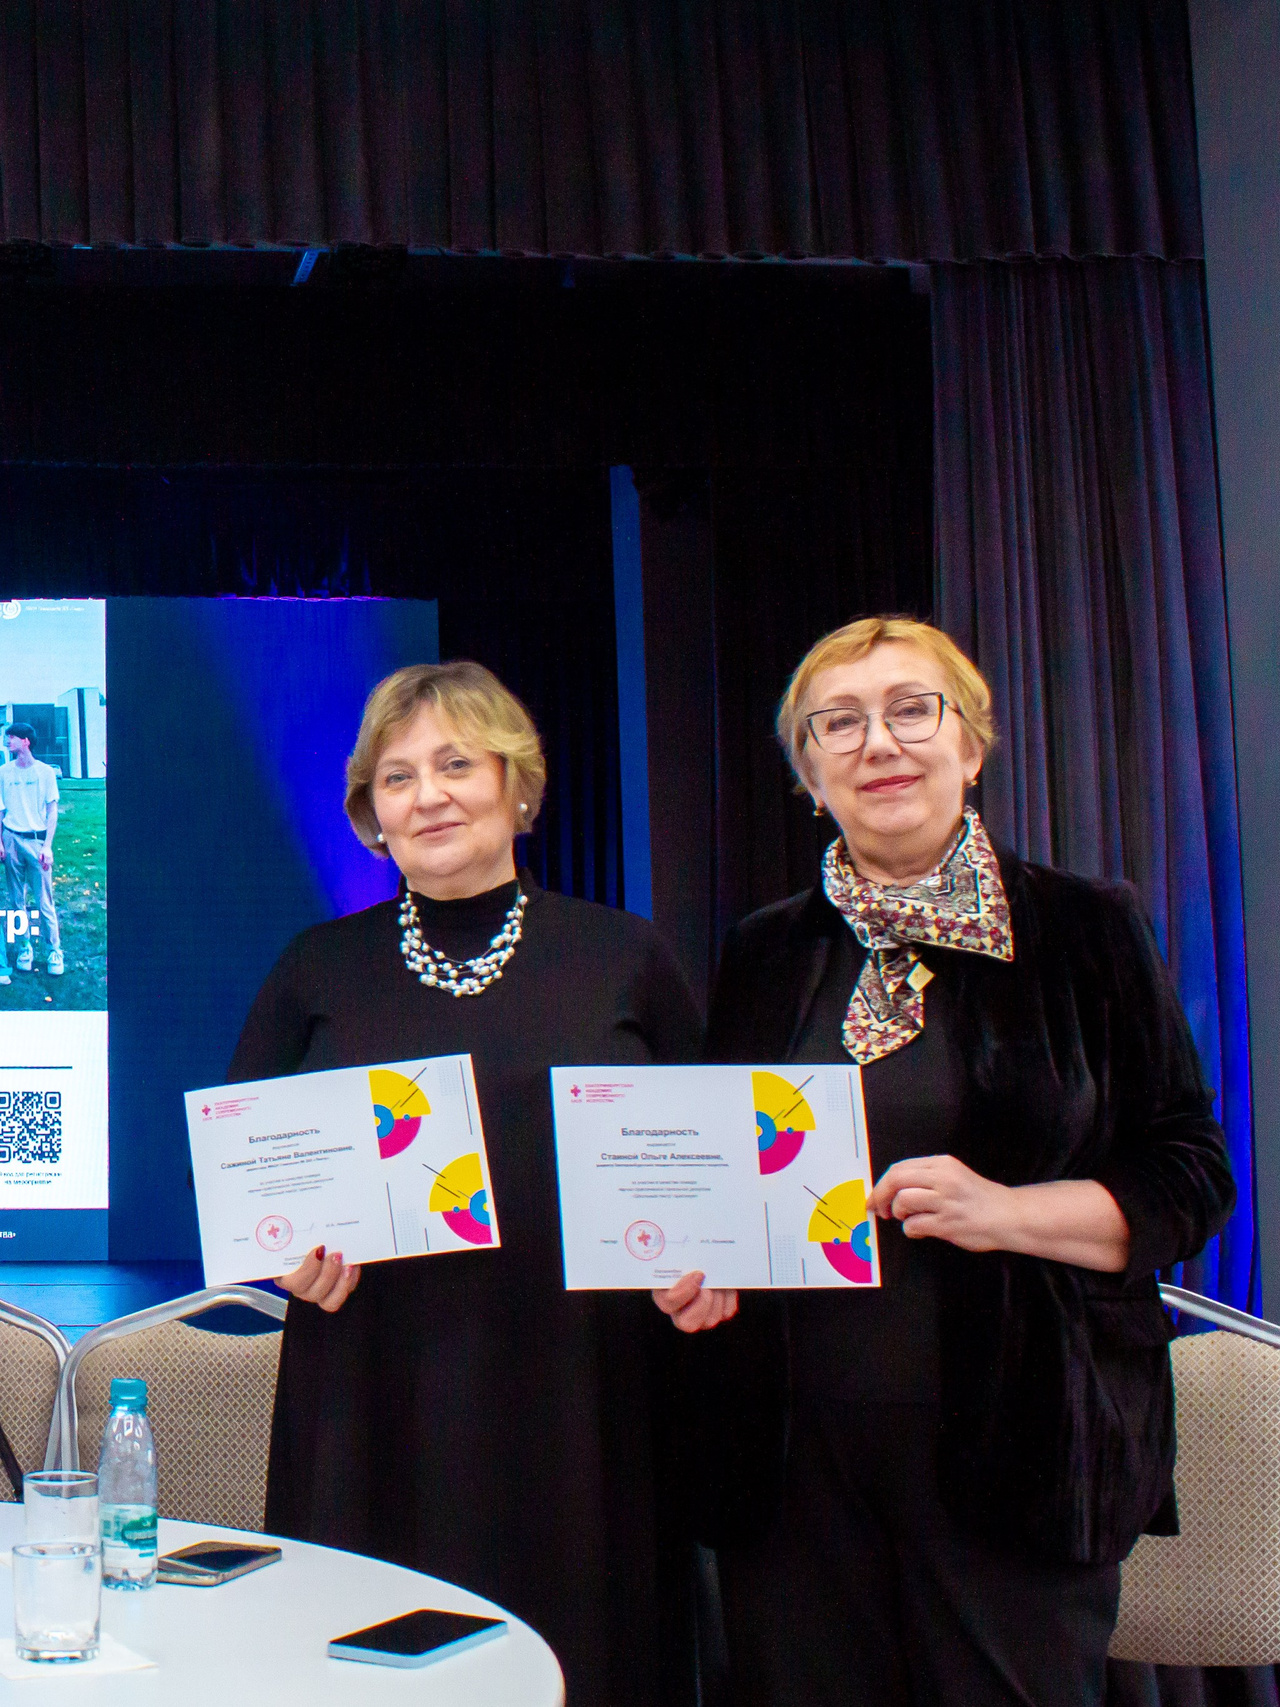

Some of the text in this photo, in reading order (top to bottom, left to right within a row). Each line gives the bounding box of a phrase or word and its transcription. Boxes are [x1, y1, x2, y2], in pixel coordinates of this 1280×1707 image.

[248, 1128, 320, 1144] Благодарность
[621, 1127, 699, 1138] Благодарность
[259, 1154, 292, 1164] Татьяне
[640, 1152, 667, 1161] Ольге
